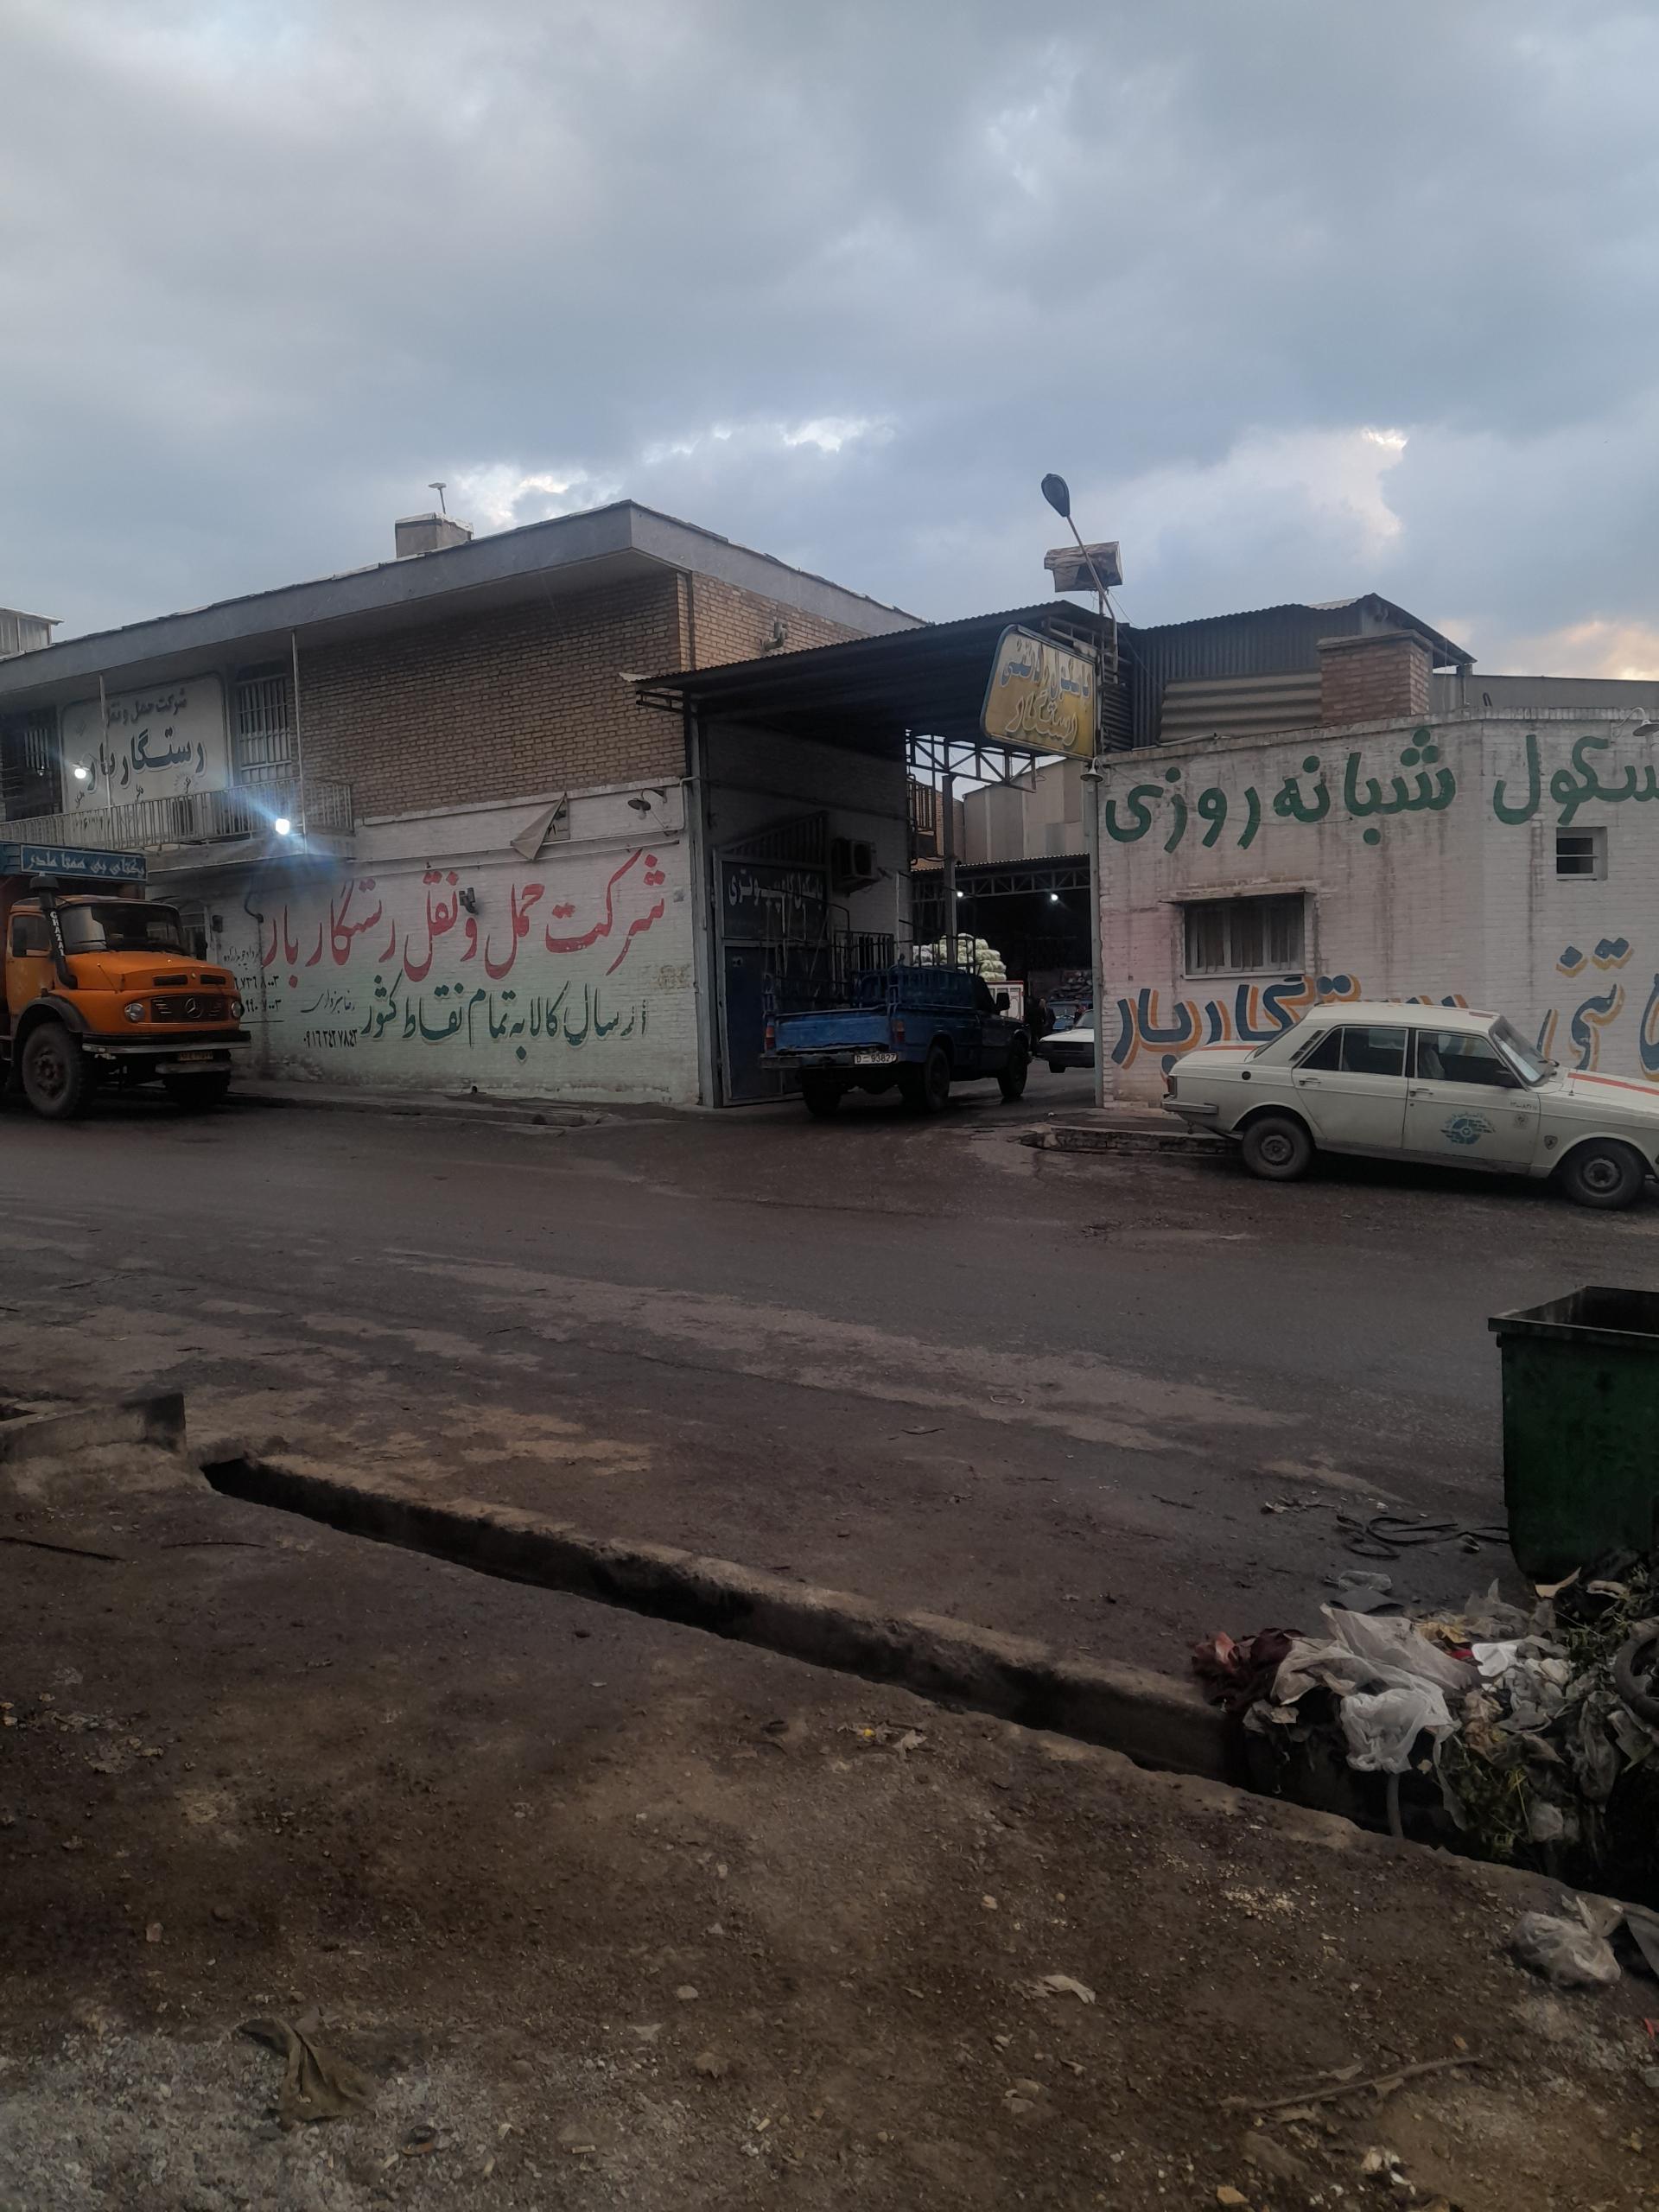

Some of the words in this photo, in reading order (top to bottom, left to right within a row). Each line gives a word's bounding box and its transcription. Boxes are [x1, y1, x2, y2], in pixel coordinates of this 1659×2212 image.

[156, 687, 188, 715] شرکت
[1005, 689, 1078, 747] رستگار
[120, 726, 205, 786] رستگار
[1273, 728, 1456, 846] شبانه
[1105, 766, 1262, 854] روزی
[49, 911, 66, 957] GHAZAL
[305, 879, 397, 968] رستگار
[404, 870, 460, 982] نقل
[460, 917, 478, 963] و
[485, 883, 546, 980] حمل
[546, 849, 666, 976] شرکت
[263, 905, 300, 988] بار
[361, 969, 404, 1039] کشور
[402, 982, 465, 1041] نقاط
[468, 988, 517, 1048] تمام
[510, 1007, 529, 1061] به
[530, 981, 570, 1037] کالا
[564, 982, 648, 1047] ارسال
